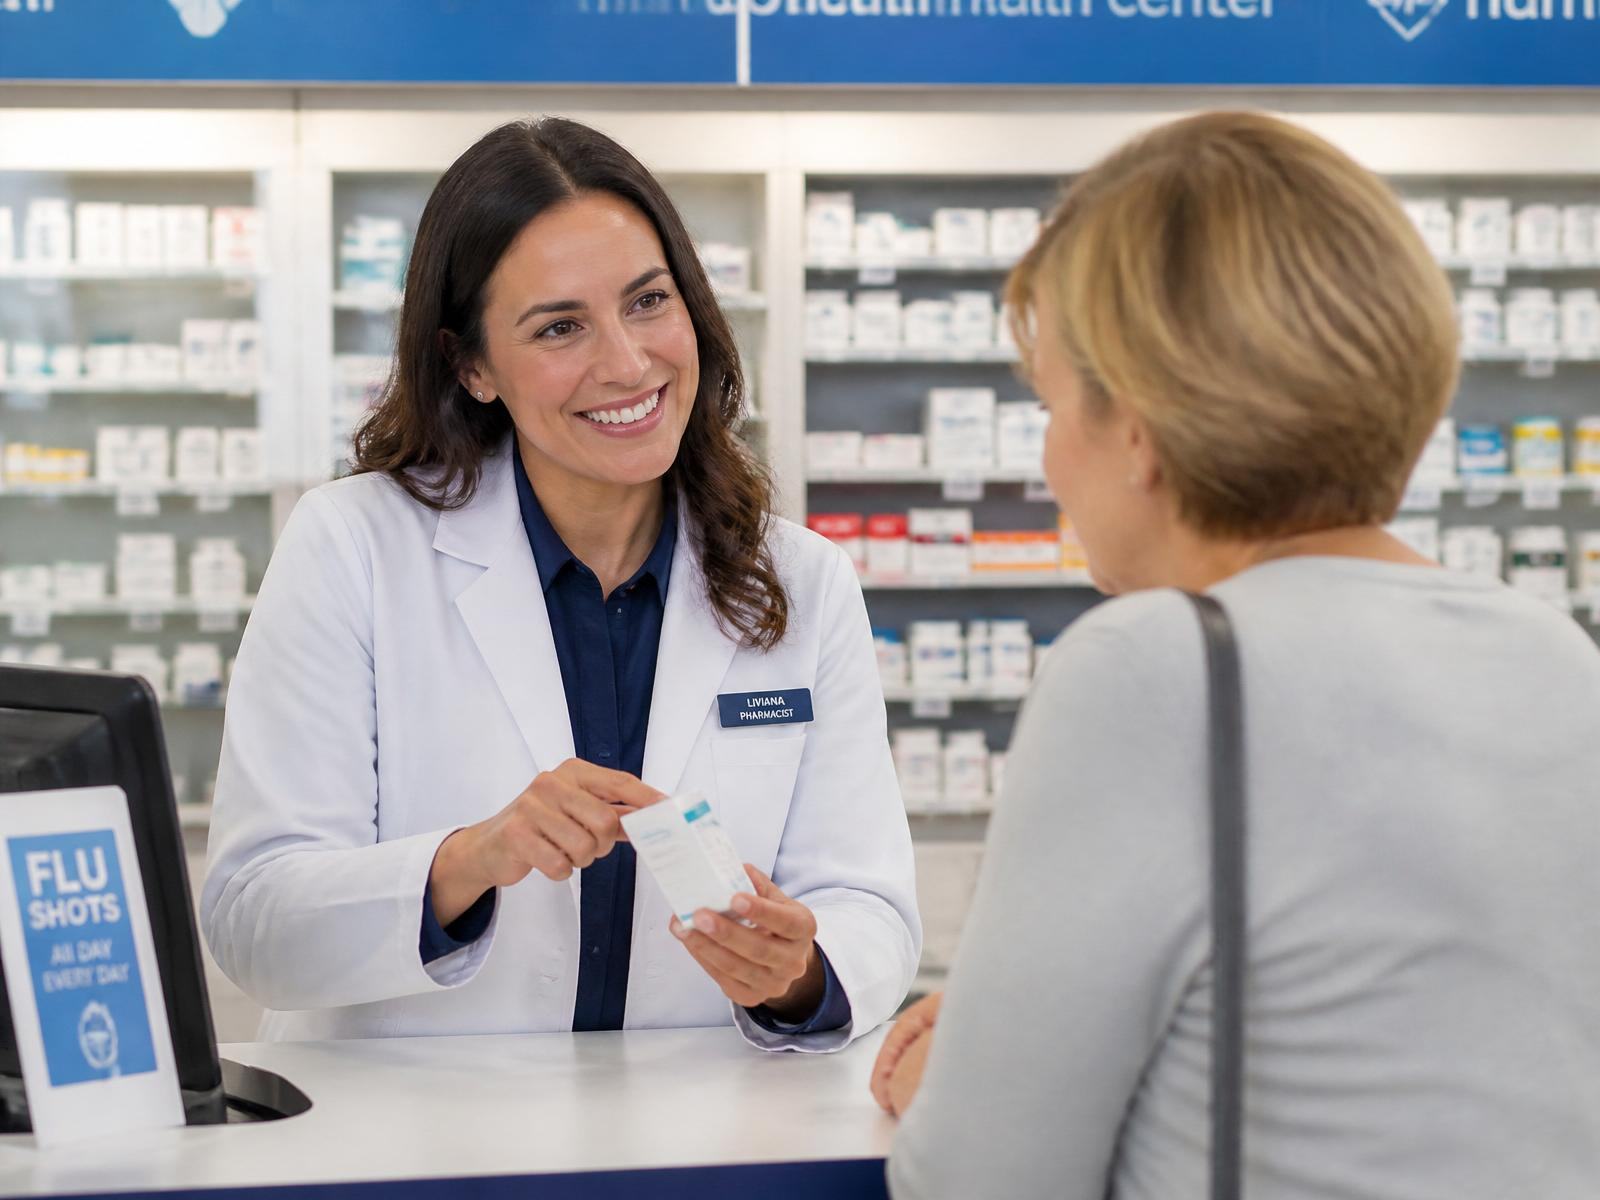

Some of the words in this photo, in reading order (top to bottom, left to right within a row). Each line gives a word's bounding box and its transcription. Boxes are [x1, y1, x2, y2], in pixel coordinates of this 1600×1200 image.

[740, 708, 794, 720] PHARMACIST
[746, 696, 785, 708] LIVIANA
[25, 847, 108, 896] FLU
[29, 894, 120, 930] SHOTS
[77, 939, 112, 963] DAY
[42, 967, 92, 992] EVERY
[95, 962, 129, 986] DAY
